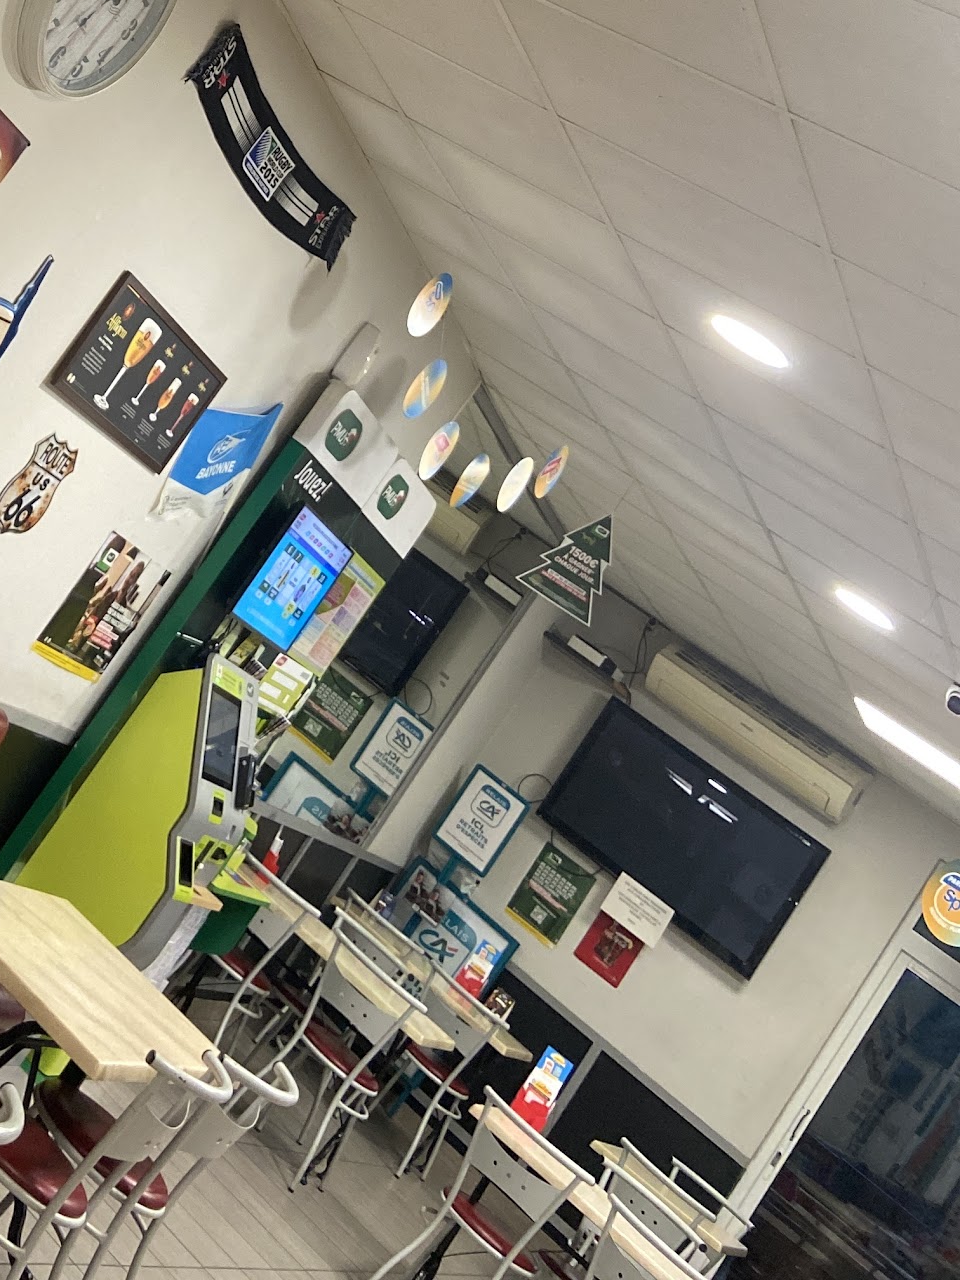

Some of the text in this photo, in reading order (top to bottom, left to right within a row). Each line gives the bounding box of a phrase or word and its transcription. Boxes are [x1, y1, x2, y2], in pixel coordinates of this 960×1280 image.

[121, 19, 138, 41] 3
[48, 46, 67, 69] 6
[204, 35, 237, 89] STAR
[273, 147, 293, 171] RUGBY
[259, 164, 279, 188] 2015
[329, 421, 349, 443] PMU
[38, 441, 74, 475] ROUTE
[195, 460, 235, 478] BAYONNE
[30, 471, 51, 491] US
[291, 458, 335, 502] Jouez!
[381, 484, 398, 504] PMU
[2, 488, 41, 528] 66
[553, 555, 579, 573] CHAQUE
[567, 544, 599, 569] 1500€
[458, 818, 489, 844] RETRAITS
[469, 817, 487, 833] ICI,
